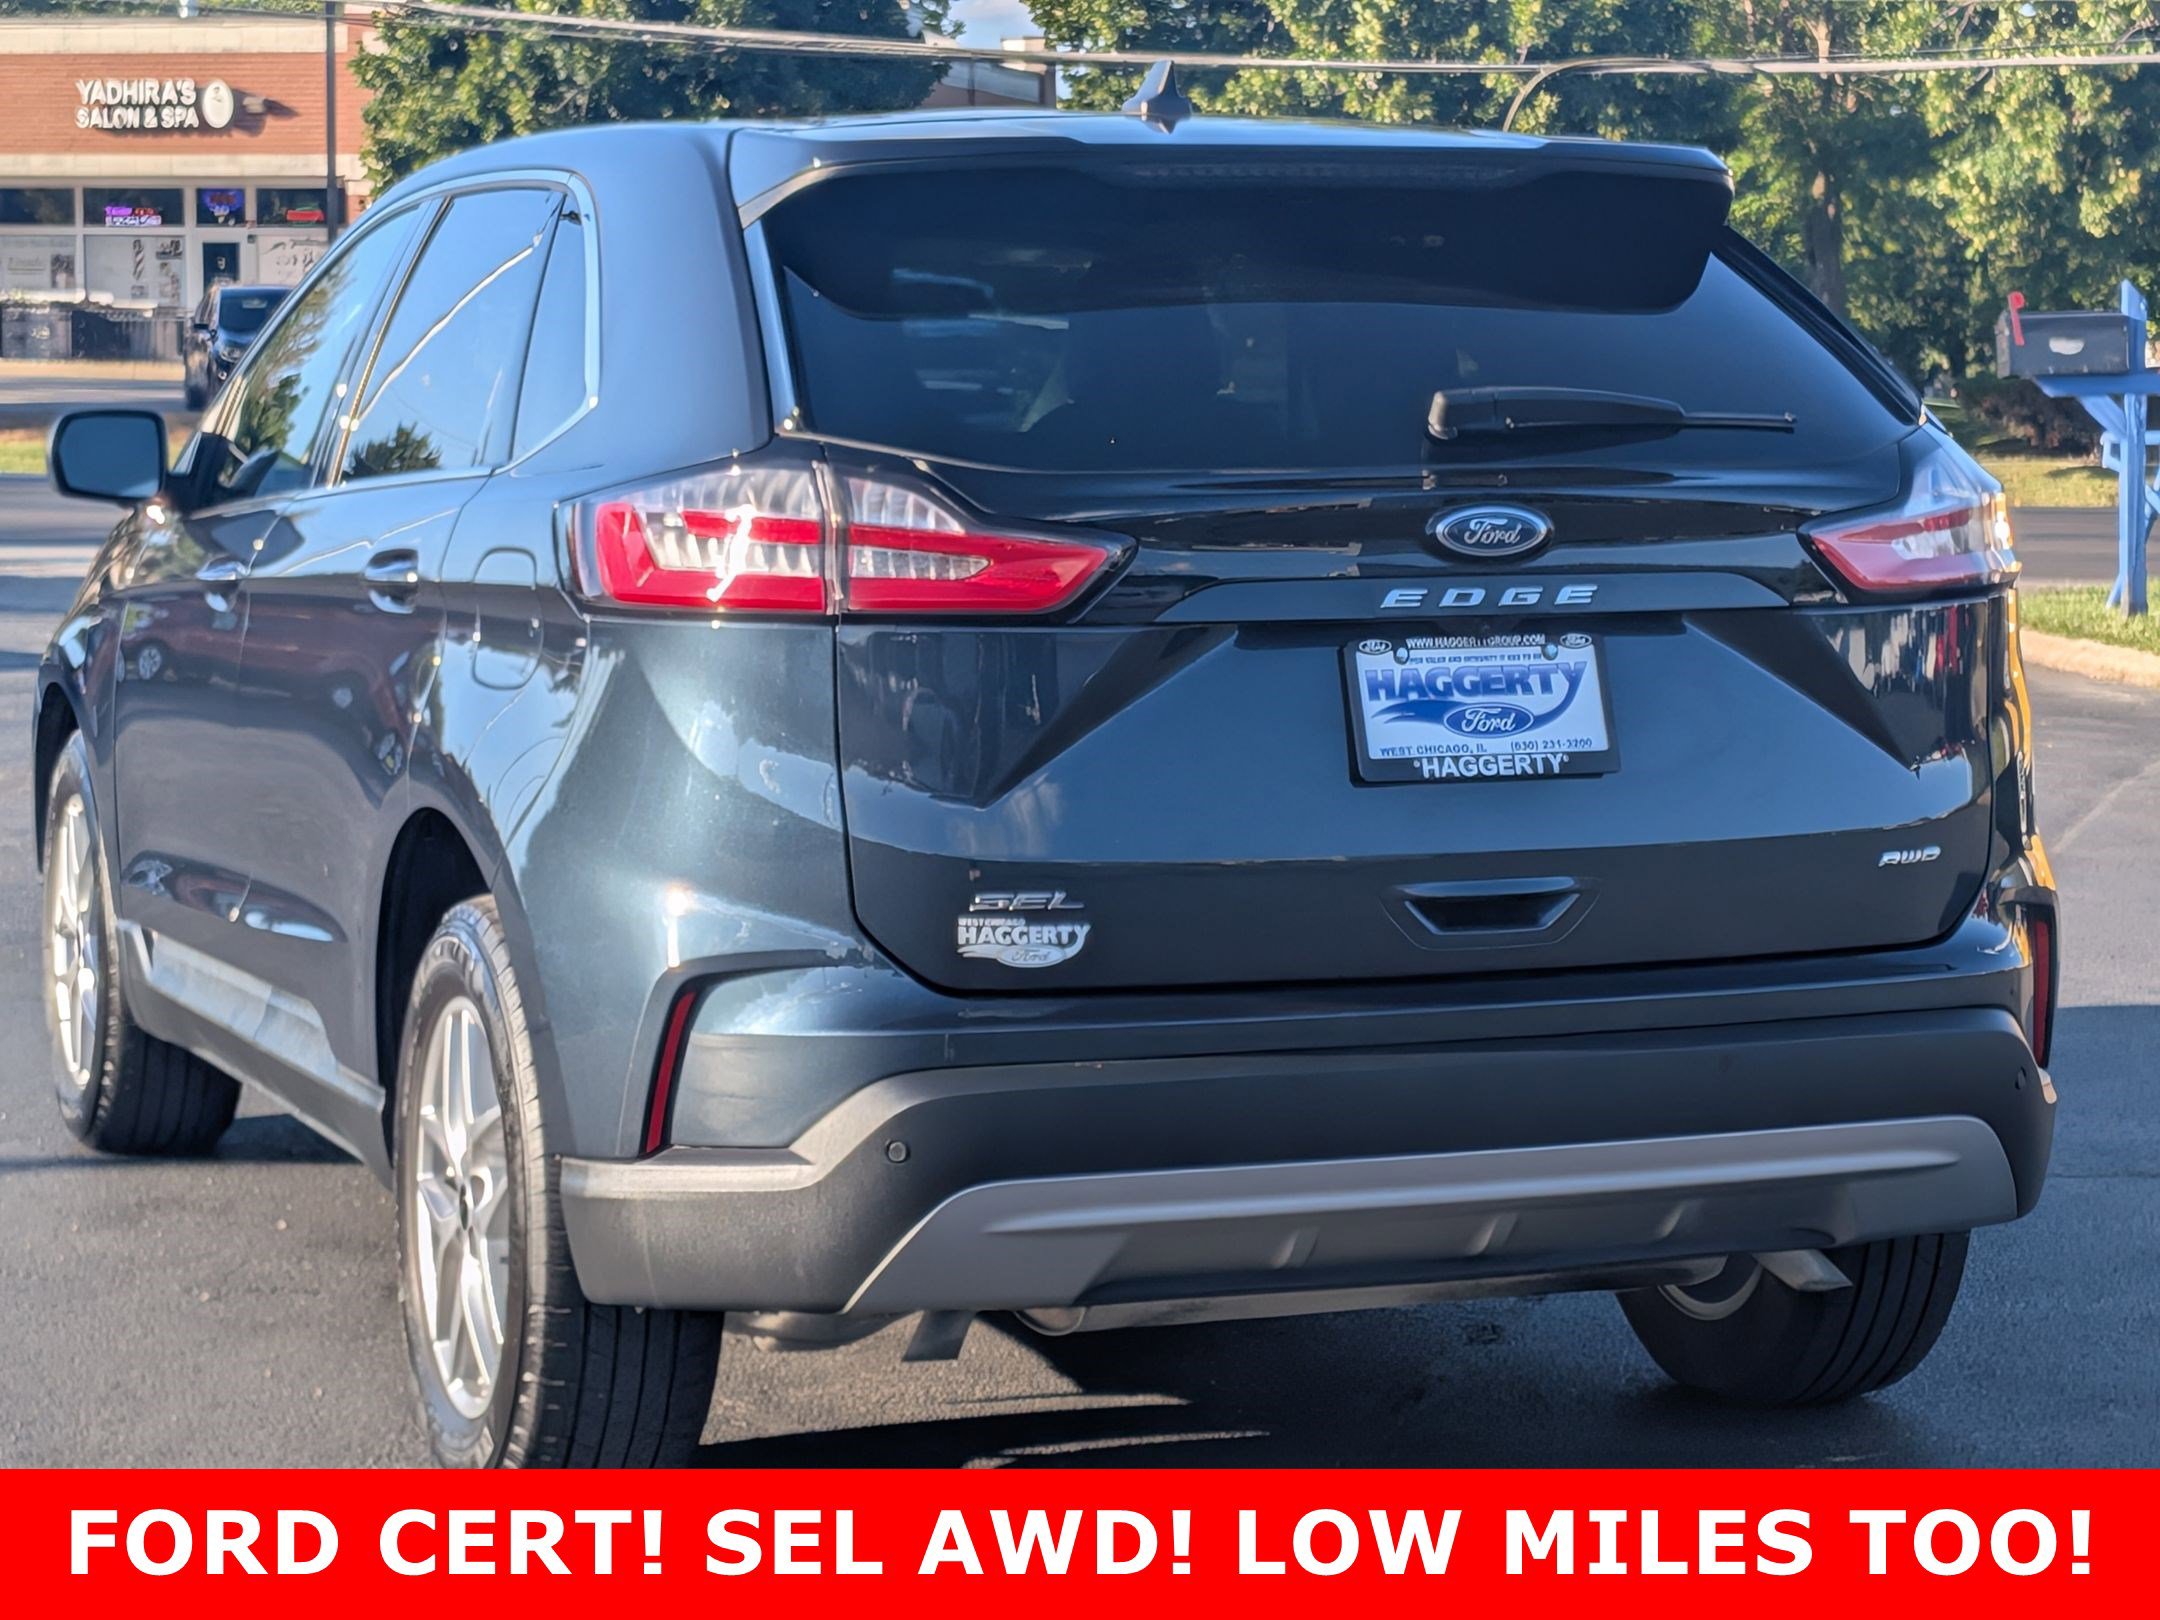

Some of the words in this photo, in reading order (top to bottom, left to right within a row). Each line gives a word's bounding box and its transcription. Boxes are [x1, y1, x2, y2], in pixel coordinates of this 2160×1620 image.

[75, 78, 197, 105] YADHIRA'S
[75, 106, 139, 129] SALON
[143, 107, 158, 129] &
[161, 106, 199, 129] SPA
[1464, 518, 1522, 545] Ford
[1380, 583, 1599, 609] EDGE
[1364, 661, 1588, 702] HAGGERTY
[1462, 707, 1516, 733] Ford
[1380, 745, 1412, 757] WEST
[1476, 742, 1487, 753] IL
[1878, 846, 1942, 867] AWD
[969, 890, 1085, 912] SEL
[957, 924, 1091, 945] HAGGERTY
[1011, 950, 1052, 962] Ford
